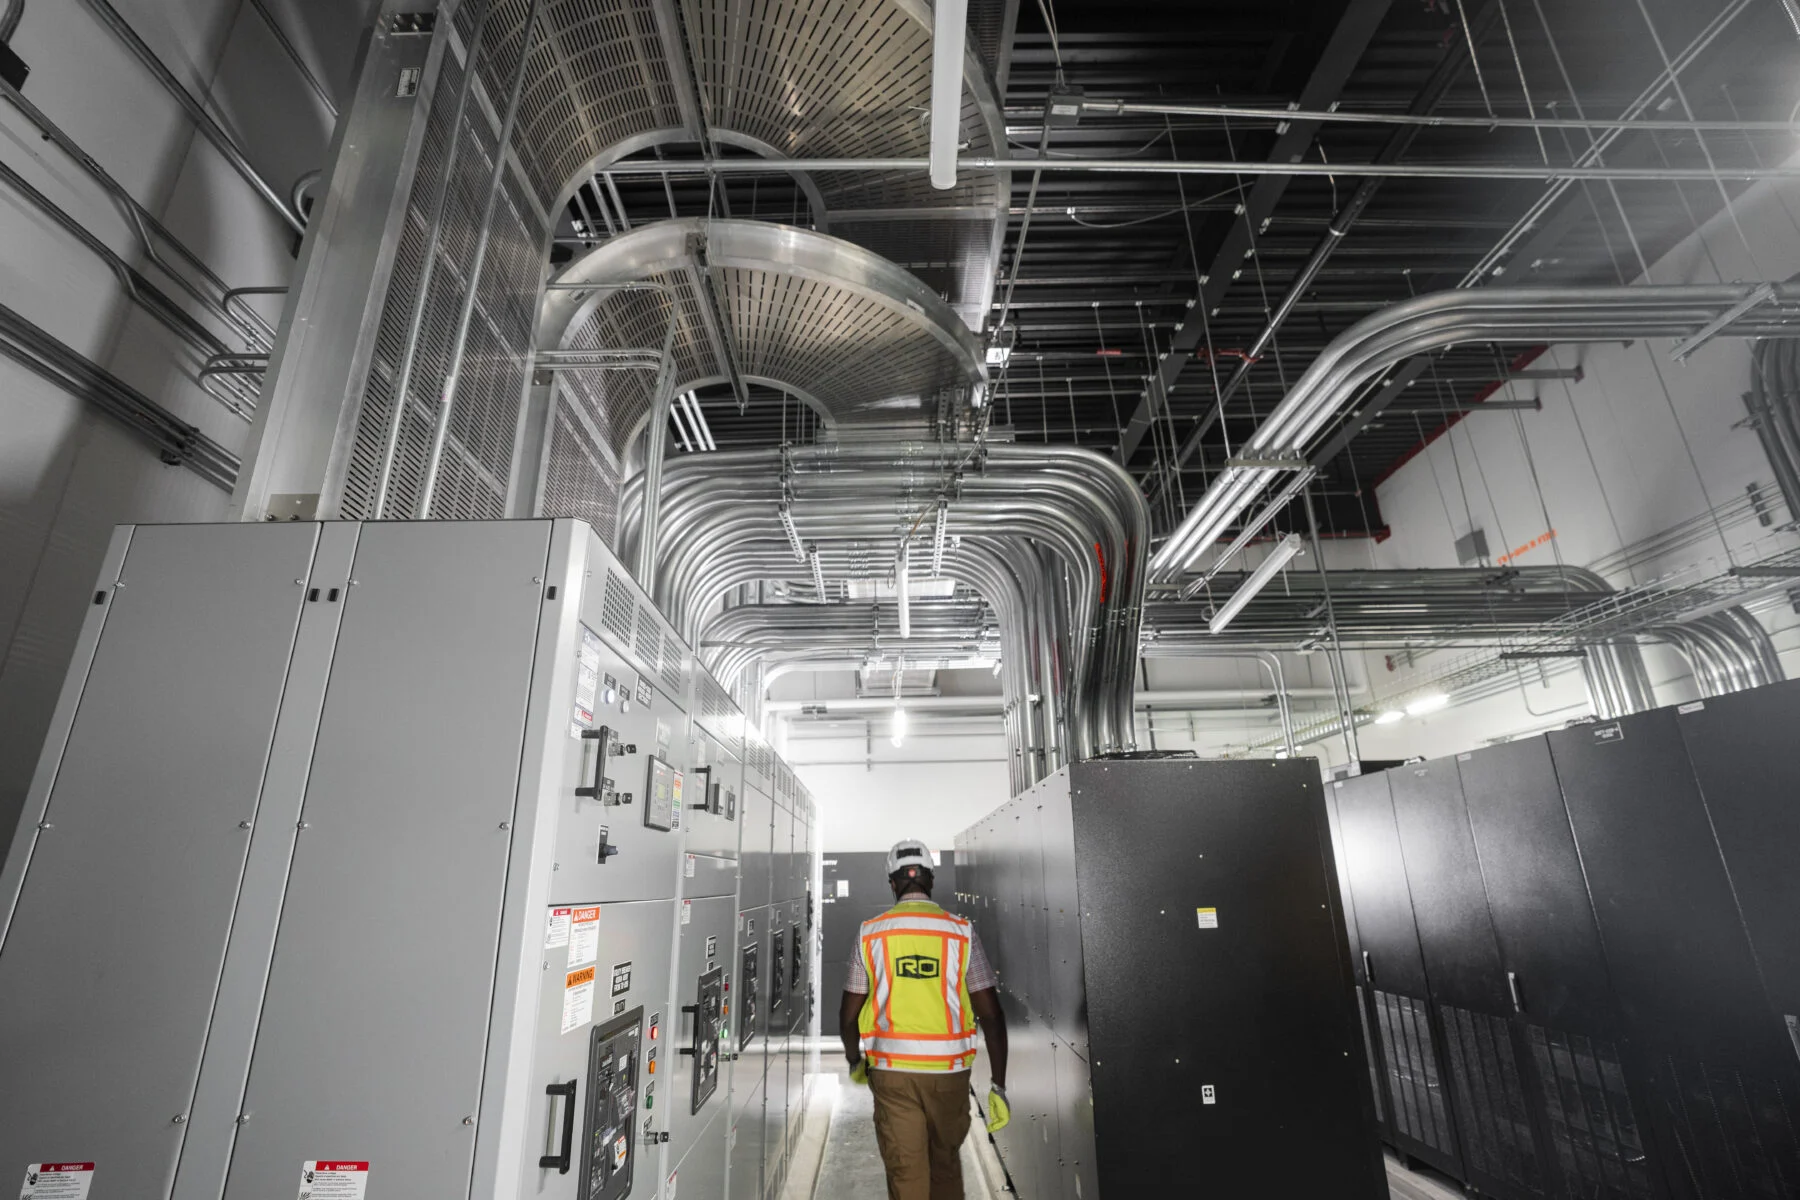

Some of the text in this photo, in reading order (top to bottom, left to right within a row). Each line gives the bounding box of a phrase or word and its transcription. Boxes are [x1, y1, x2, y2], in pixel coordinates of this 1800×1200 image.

[579, 909, 596, 920] DANGER
[898, 958, 938, 976] RO
[572, 969, 593, 983] WARNING
